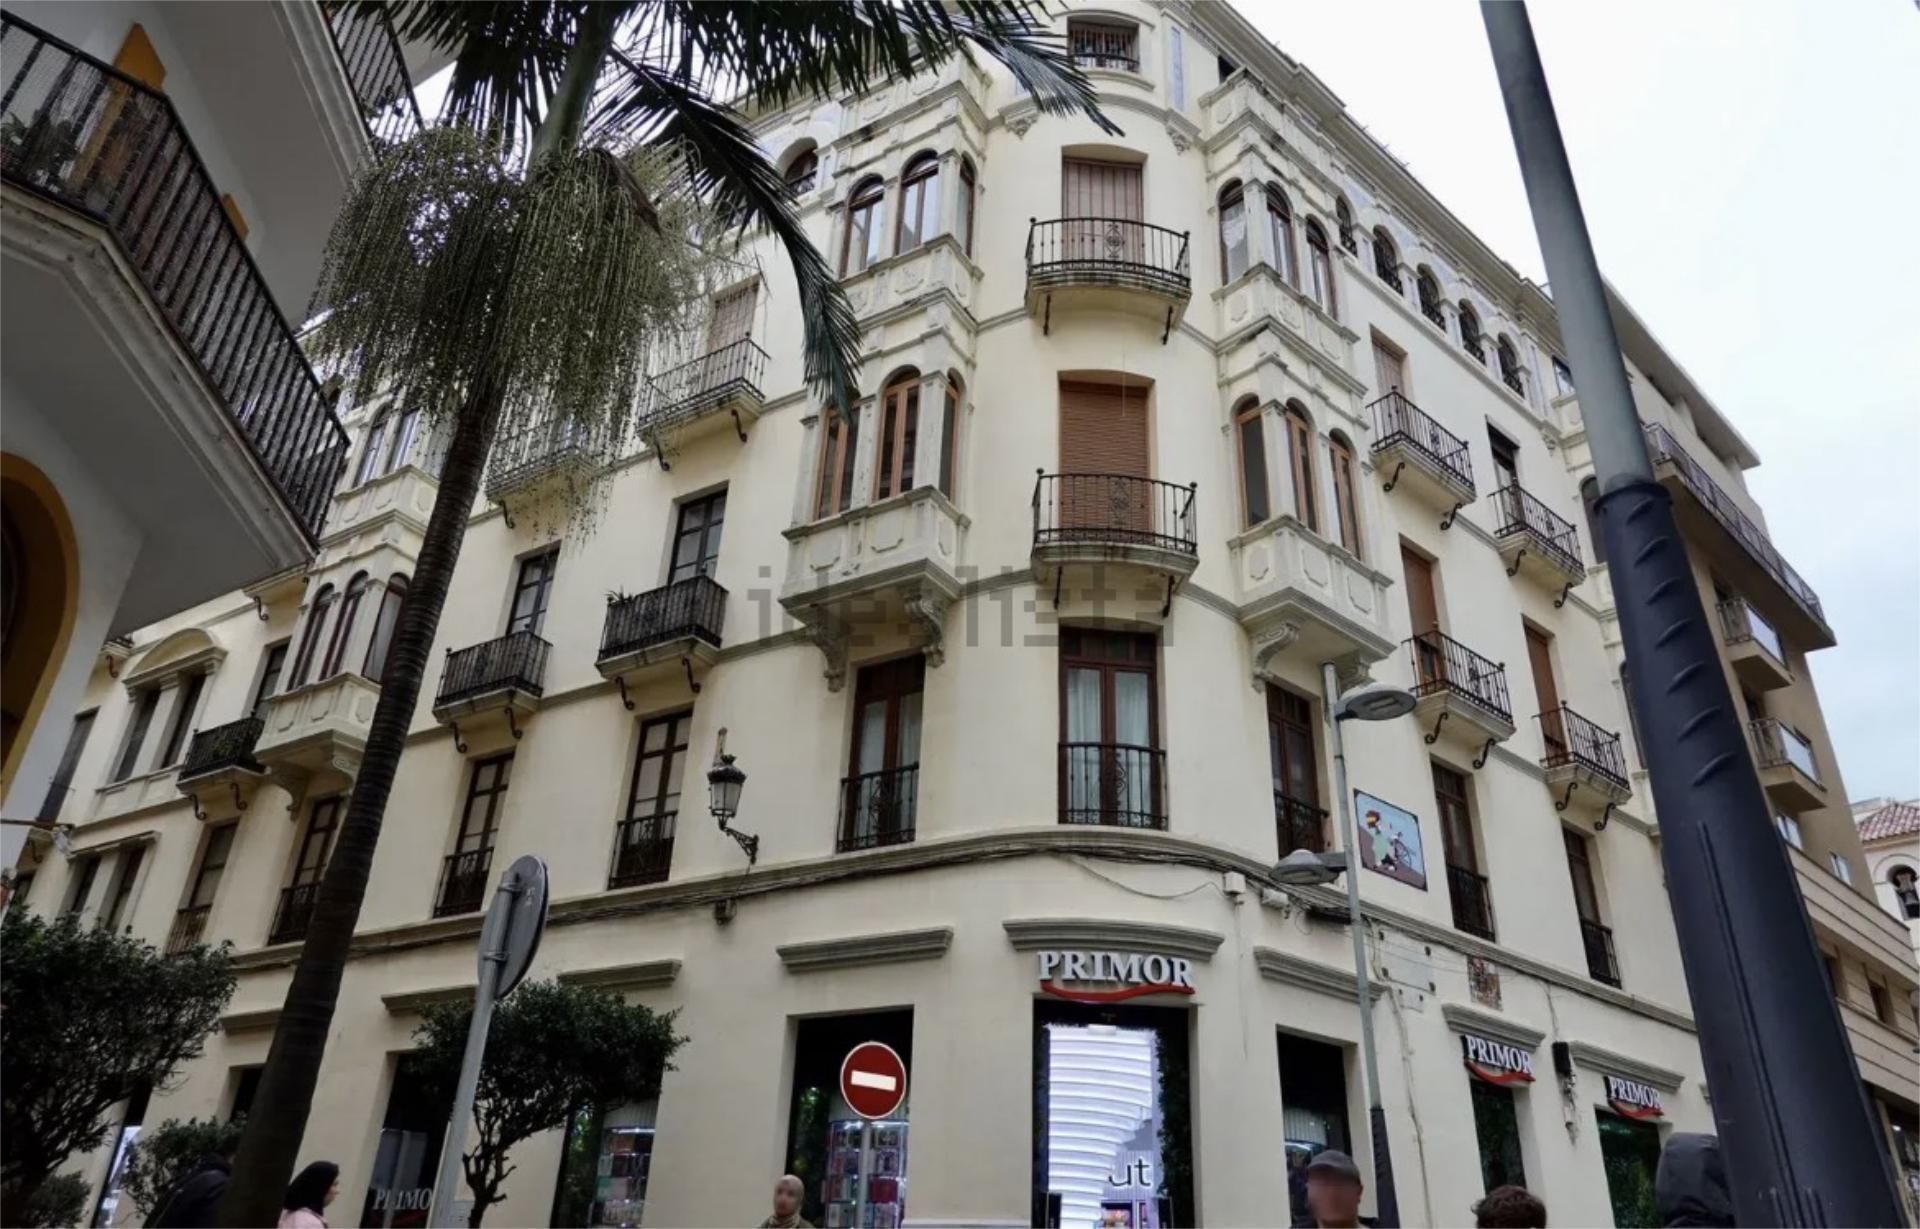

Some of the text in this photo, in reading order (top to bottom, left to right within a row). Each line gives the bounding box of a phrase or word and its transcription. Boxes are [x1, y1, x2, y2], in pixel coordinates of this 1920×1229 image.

[1037, 951, 1195, 988] PRIMOR
[1464, 1034, 1535, 1076] PRIMOR
[1607, 1076, 1664, 1109] PRIMOR
[373, 1188, 433, 1210] PIMO
